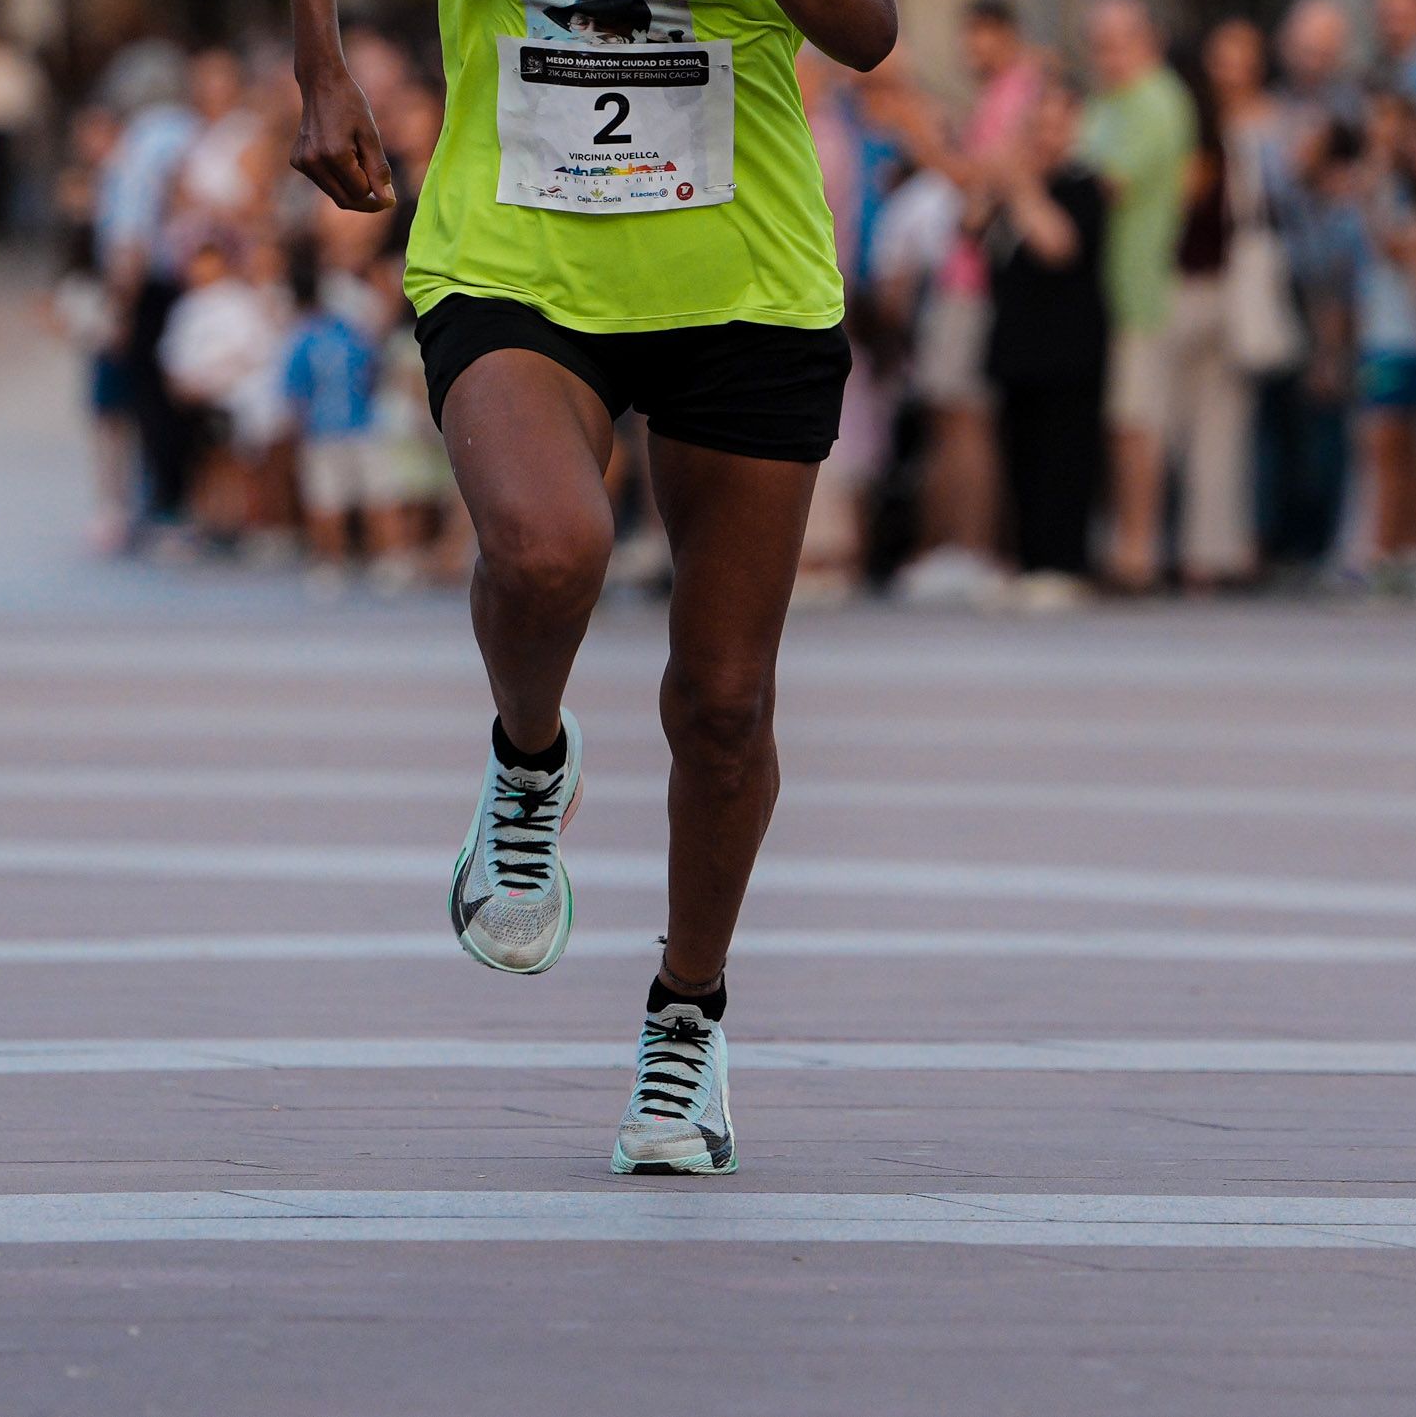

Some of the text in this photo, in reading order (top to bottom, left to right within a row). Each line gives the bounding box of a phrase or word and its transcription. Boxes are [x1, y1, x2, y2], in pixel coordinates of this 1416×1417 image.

[546, 56, 574, 65] MEDIO
[575, 58, 620, 67] MARATÓN
[621, 59, 657, 67] CIUDAD
[673, 58, 701, 66] SORIA
[547, 69, 560, 77] 21K
[561, 70, 583, 79] ABEL
[584, 70, 615, 80] ANTÓN
[633, 70, 667, 79] FERMÍN
[668, 71, 700, 79] CACHO
[593, 92, 632, 144] 2
[568, 151, 659, 161] VIRGINIA QUELLCA
[625, 175, 675, 184] SORIA
[577, 195, 591, 203] Caja
